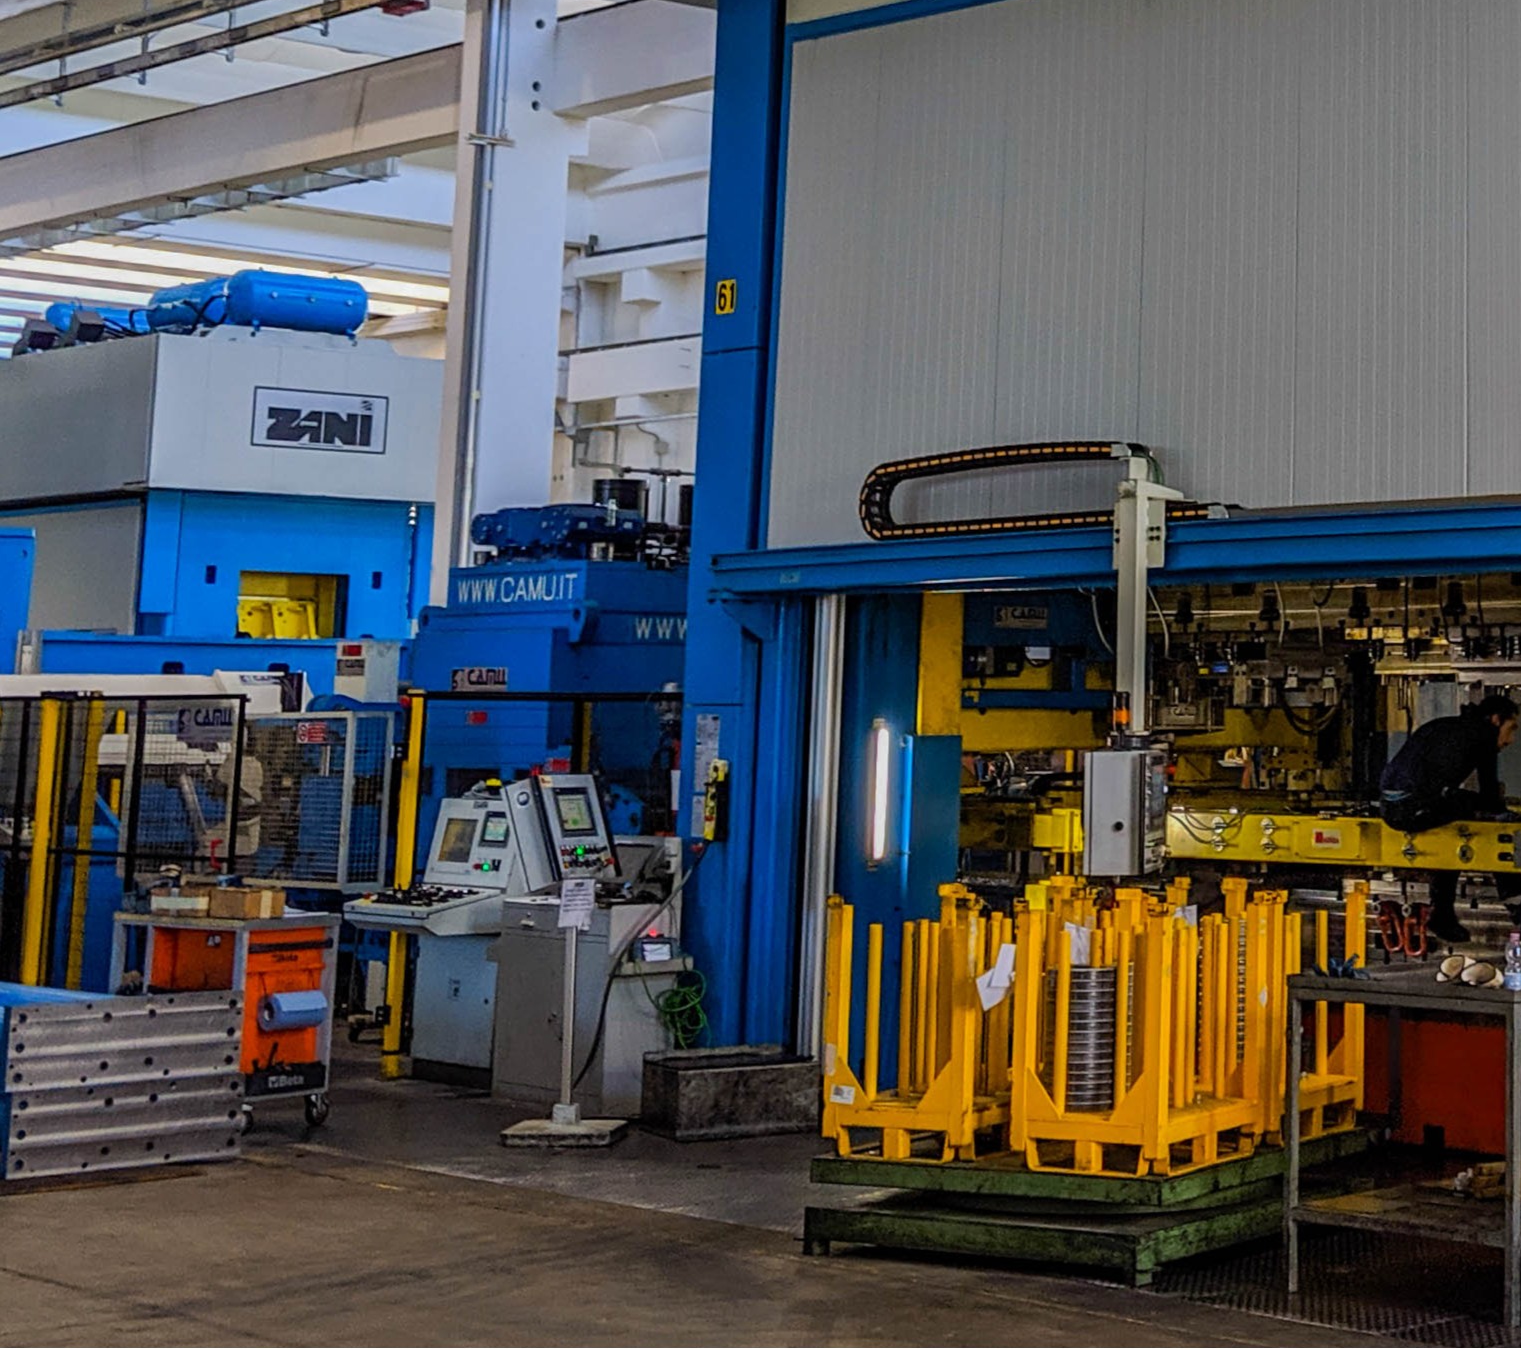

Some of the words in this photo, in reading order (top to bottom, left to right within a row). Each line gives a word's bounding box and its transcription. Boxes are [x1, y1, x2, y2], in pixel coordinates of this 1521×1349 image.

[718, 283, 735, 311] 61
[266, 400, 373, 447] ZANI
[458, 573, 578, 603] WWW.CAMU.IT
